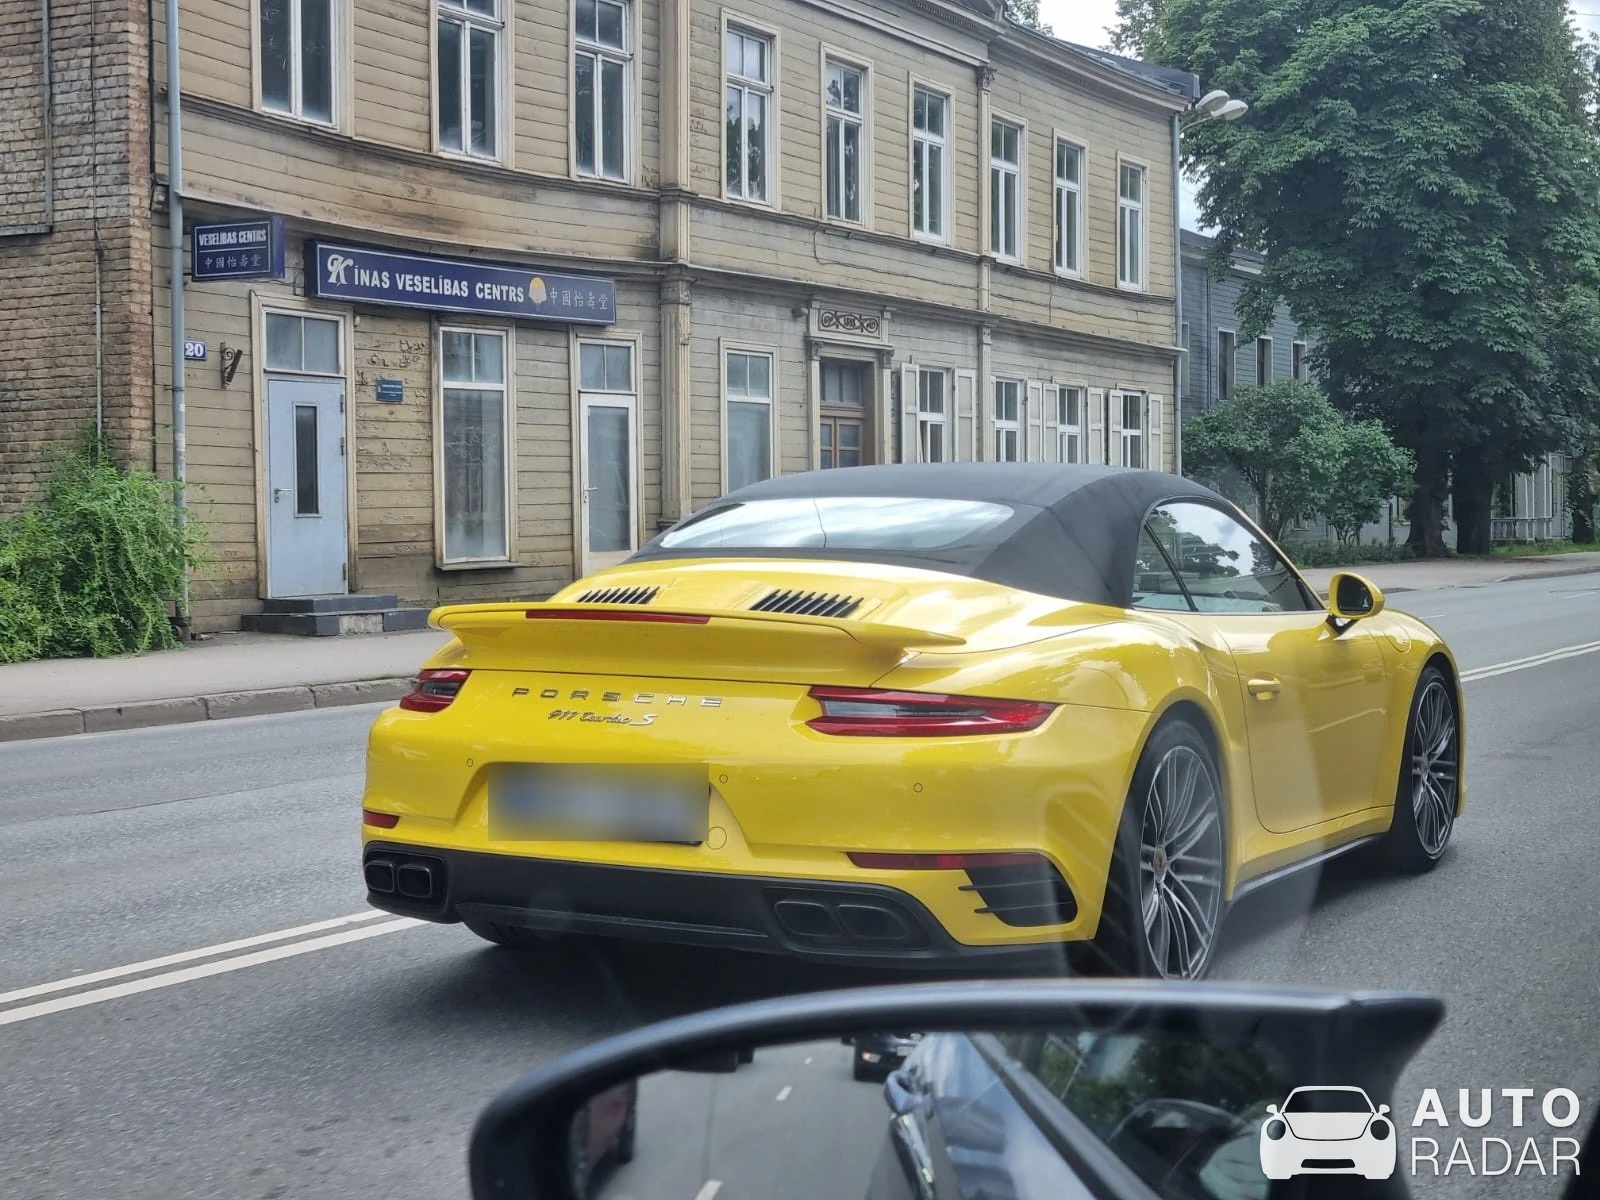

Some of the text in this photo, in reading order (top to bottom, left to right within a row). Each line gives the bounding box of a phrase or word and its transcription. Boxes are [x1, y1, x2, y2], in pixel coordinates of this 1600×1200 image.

[475, 282, 524, 303] CENTRS
[185, 343, 204, 357] 20
[512, 687, 723, 708] PORSCHE
[548, 709, 578, 721] 911
[630, 713, 659, 726] S
